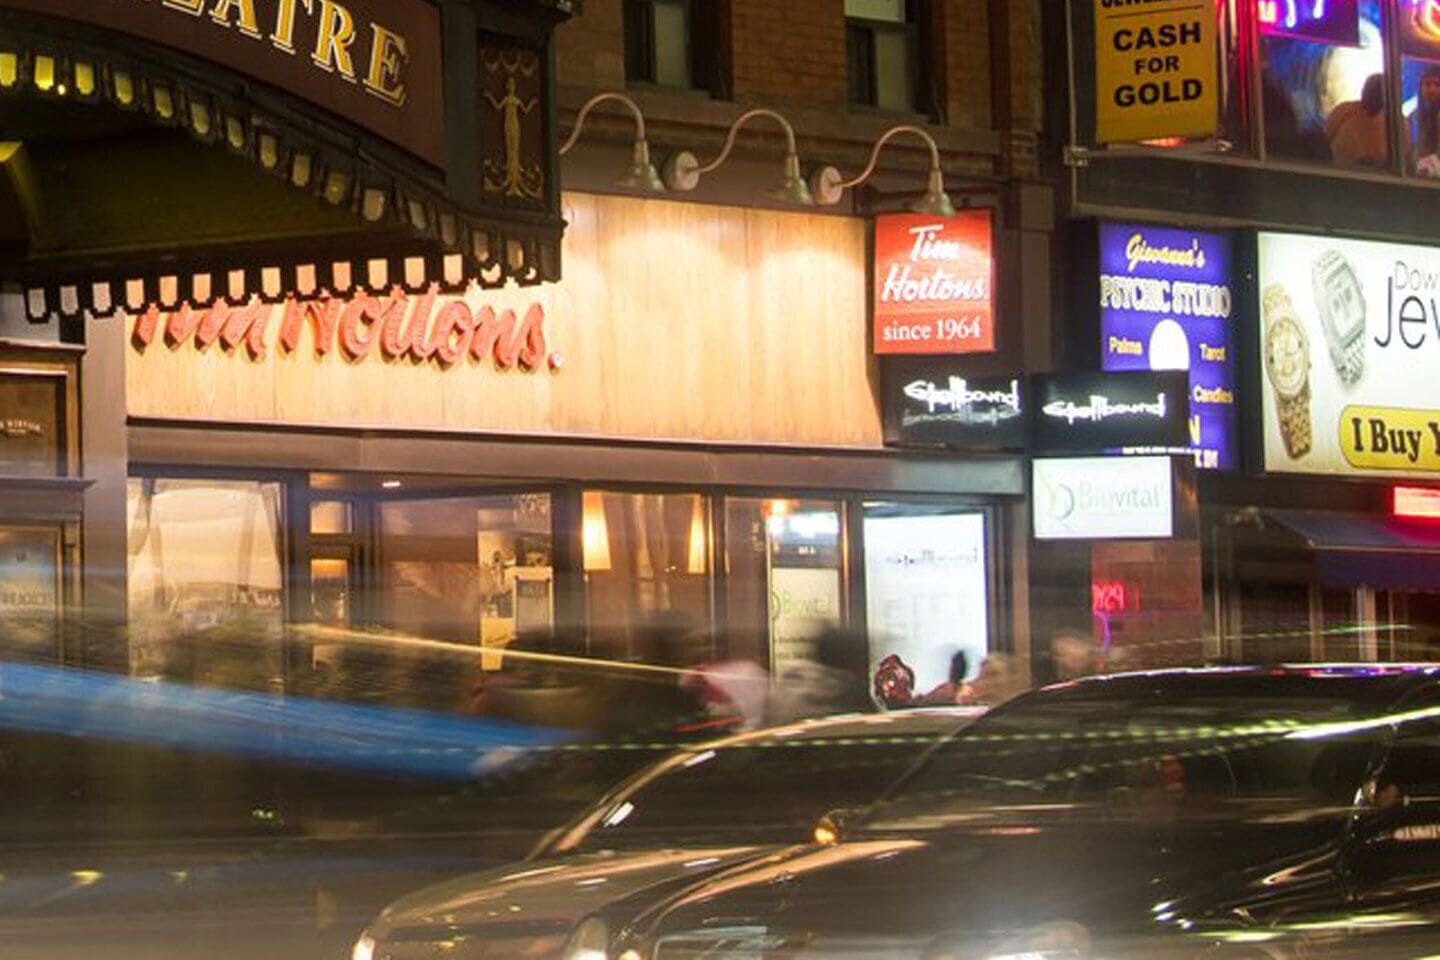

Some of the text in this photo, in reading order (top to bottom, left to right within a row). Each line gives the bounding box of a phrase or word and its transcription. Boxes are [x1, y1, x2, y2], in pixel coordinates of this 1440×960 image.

[1113, 21, 1202, 53] CASH
[1134, 55, 1180, 75] FOR
[1113, 78, 1203, 108] GOLD
[909, 224, 961, 262] Tim
[1172, 280, 1232, 319] STUDIO
[882, 315, 982, 342] since 1964
[1351, 417, 1363, 453] I
[1368, 418, 1423, 462] Buy
[1078, 479, 1161, 511] Biovital
